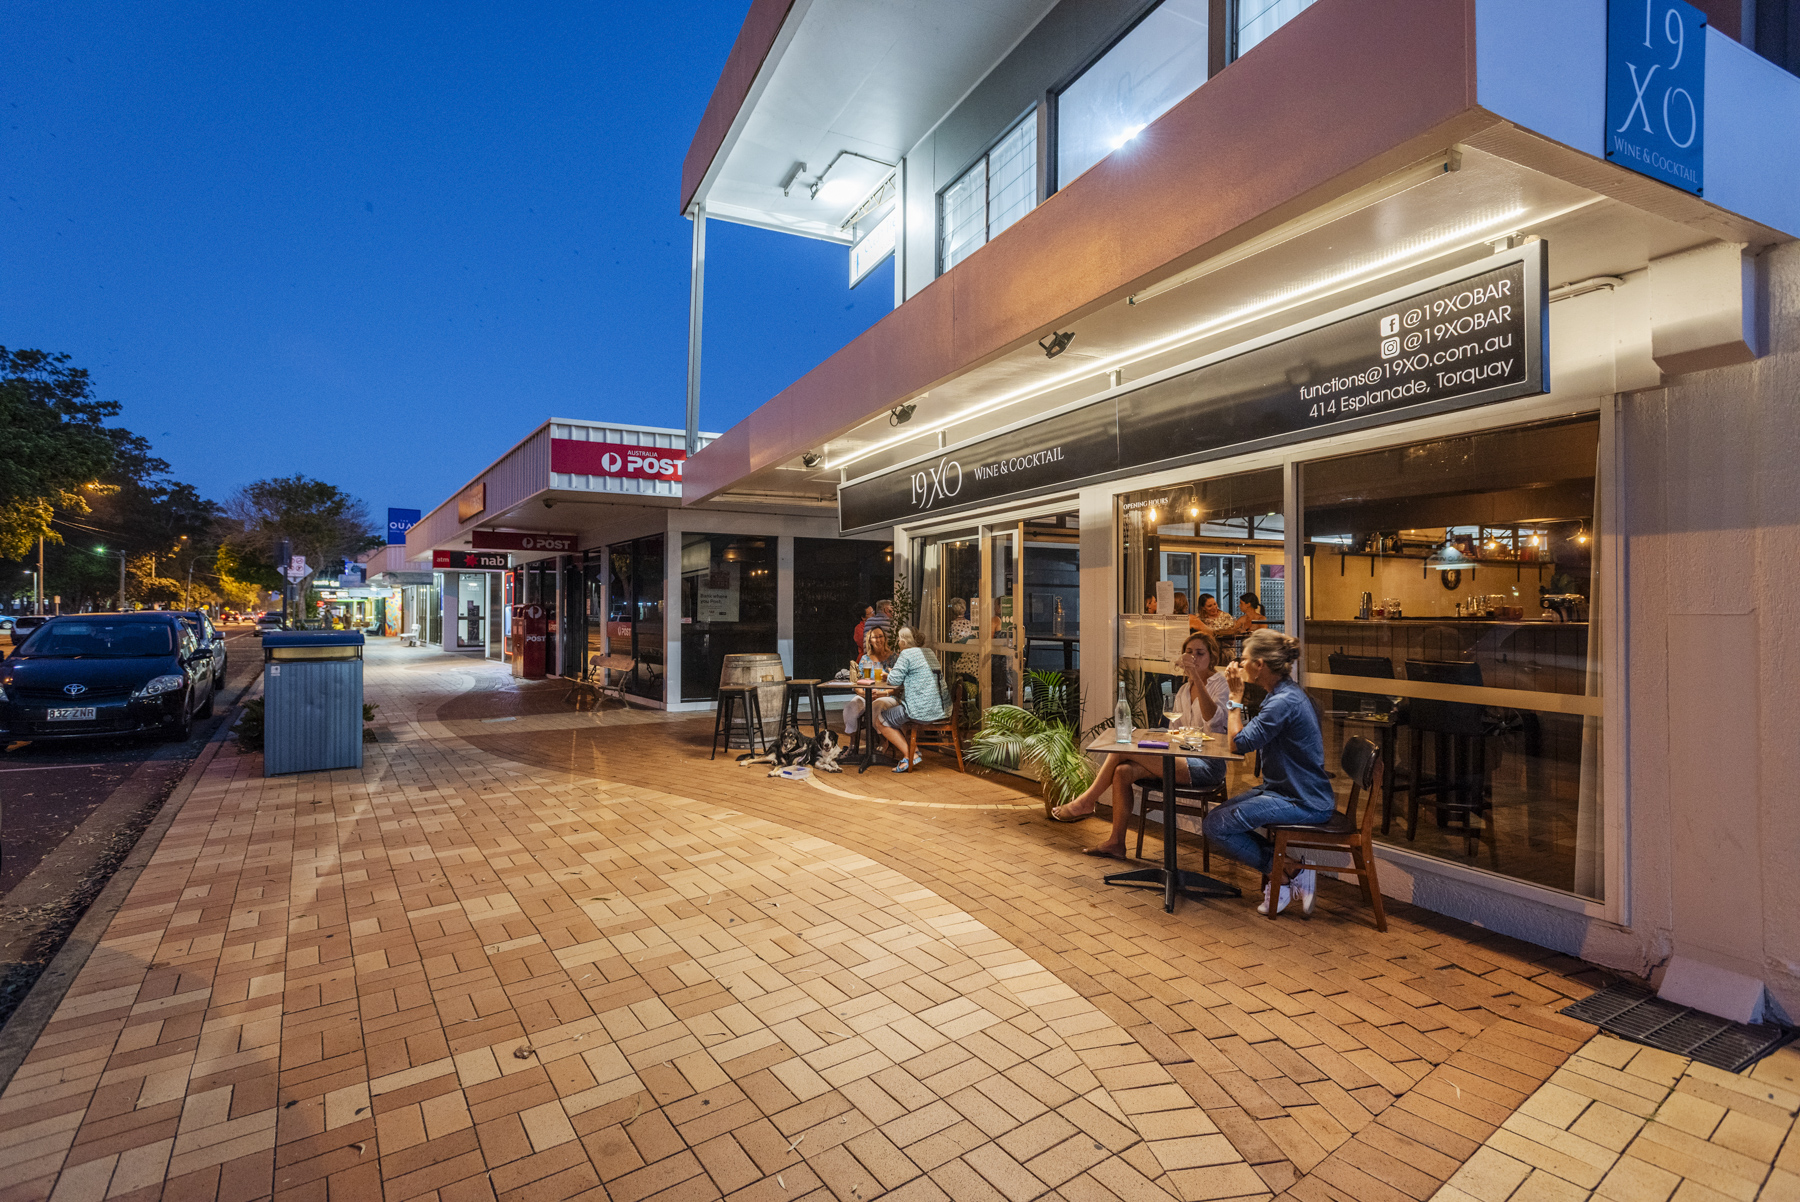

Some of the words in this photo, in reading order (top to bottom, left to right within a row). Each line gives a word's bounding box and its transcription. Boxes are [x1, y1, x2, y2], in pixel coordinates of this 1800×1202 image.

[1616, 61, 1696, 148] XO
[1643, 148, 1651, 164] &
[1652, 152, 1698, 184] COCKTAIL
[1403, 279, 1511, 328] @19XOBAR
[1403, 305, 1512, 351] @19XOBAR
[1299, 333, 1512, 400] functions@19XO.com.au
[1309, 398, 1336, 418] 414
[1340, 379, 1431, 412] Esplanade,
[1436, 358, 1514, 389] Torquay
[627, 450, 658, 458] AUSTRALIA
[627, 456, 685, 476] POST
[1000, 460, 1009, 475] &
[1009, 447, 1065, 472] COCKTAIL
[1123, 500, 1148, 510] OPENING
[1148, 497, 1169, 506] HOURS
[480, 555, 505, 566] nab
[536, 539, 571, 550] POST
